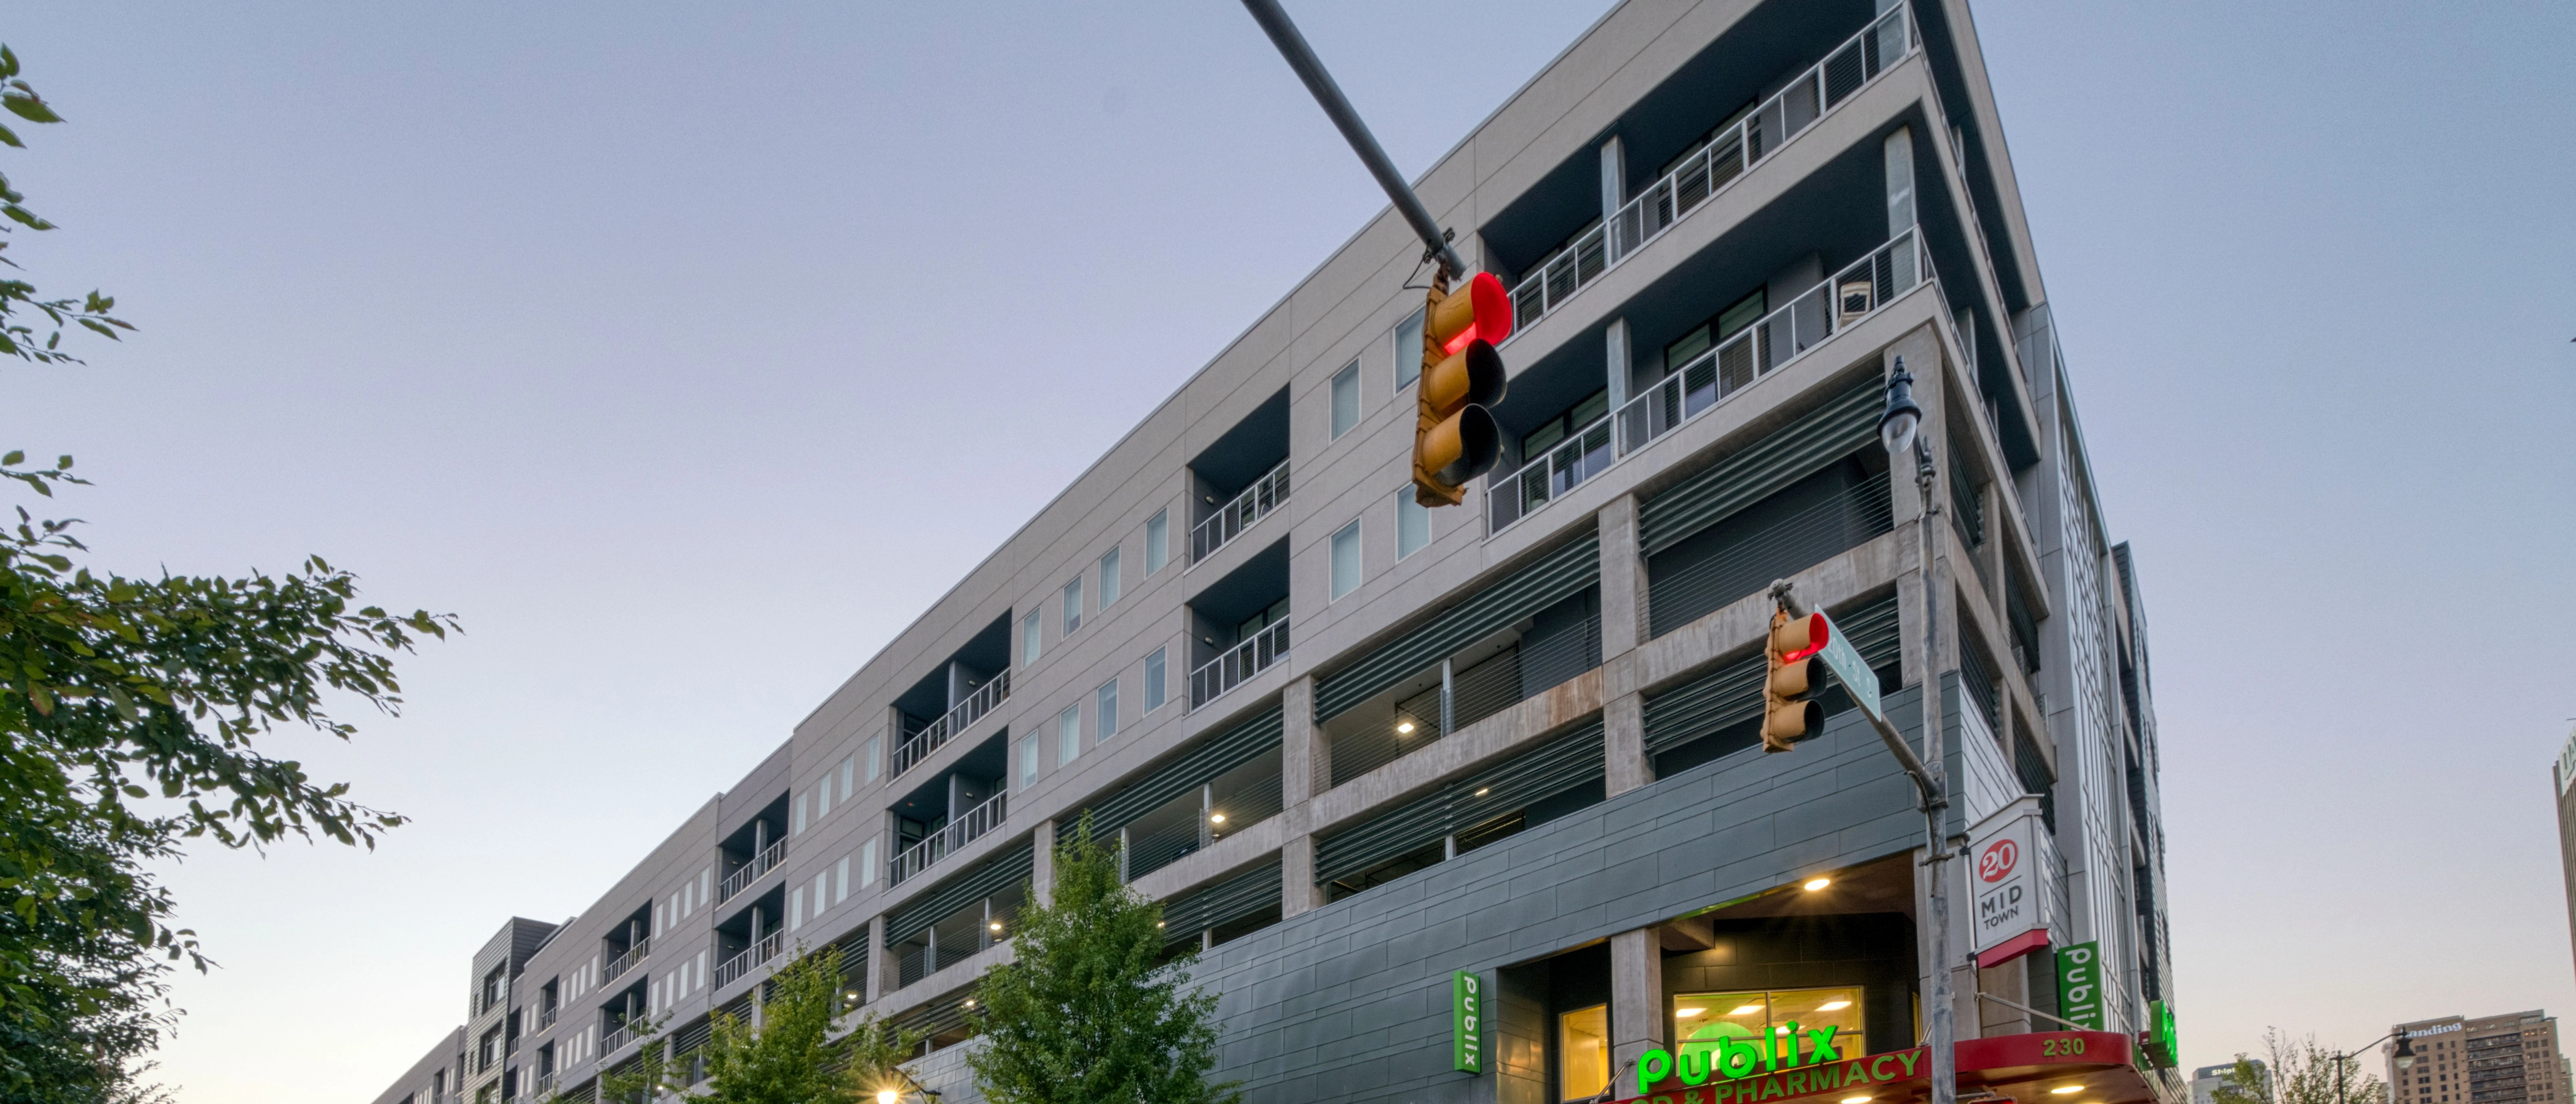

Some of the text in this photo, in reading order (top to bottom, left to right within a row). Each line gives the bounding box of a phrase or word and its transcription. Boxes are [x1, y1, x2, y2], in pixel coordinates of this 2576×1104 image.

[1852, 660, 1861, 687] St
[1867, 677, 1871, 698] S
[1983, 843, 2015, 880] 20
[1981, 885, 2022, 918] MID
[1984, 906, 2018, 930] TOWN
[1464, 976, 1477, 1066] publix
[2043, 1038, 2084, 1056] 230
[1716, 1050, 1922, 1104] PHARMACY
